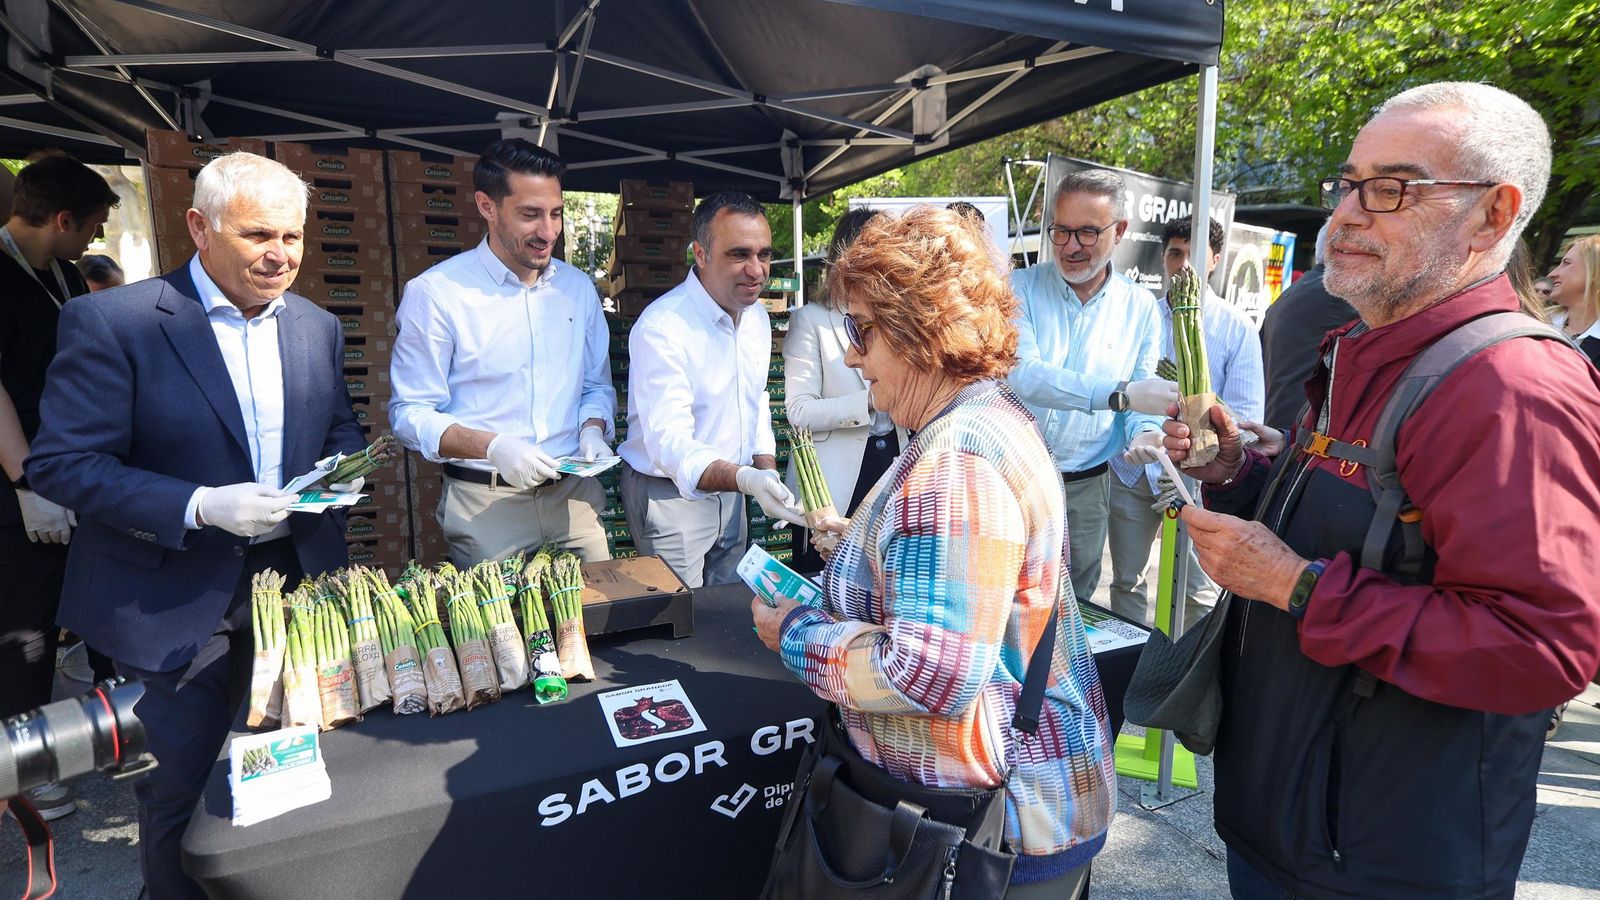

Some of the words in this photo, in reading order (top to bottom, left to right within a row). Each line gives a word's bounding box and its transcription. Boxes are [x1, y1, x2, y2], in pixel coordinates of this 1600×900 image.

[317, 160, 345, 170] Cesurca
[425, 168, 451, 177] Cesurca
[320, 193, 348, 202] Cesurca
[427, 200, 453, 209] Cesurca
[323, 226, 351, 235] Cesurca
[430, 230, 455, 238] Cesurca
[327, 257, 355, 266] Cesurca
[329, 289, 357, 298] Cesurca
[341, 321, 359, 329] surca
[605, 690, 633, 698] SABOR
[634, 683, 673, 692] GRANADA
[537, 740, 728, 827] SABOR
[765, 797, 783, 809] de
